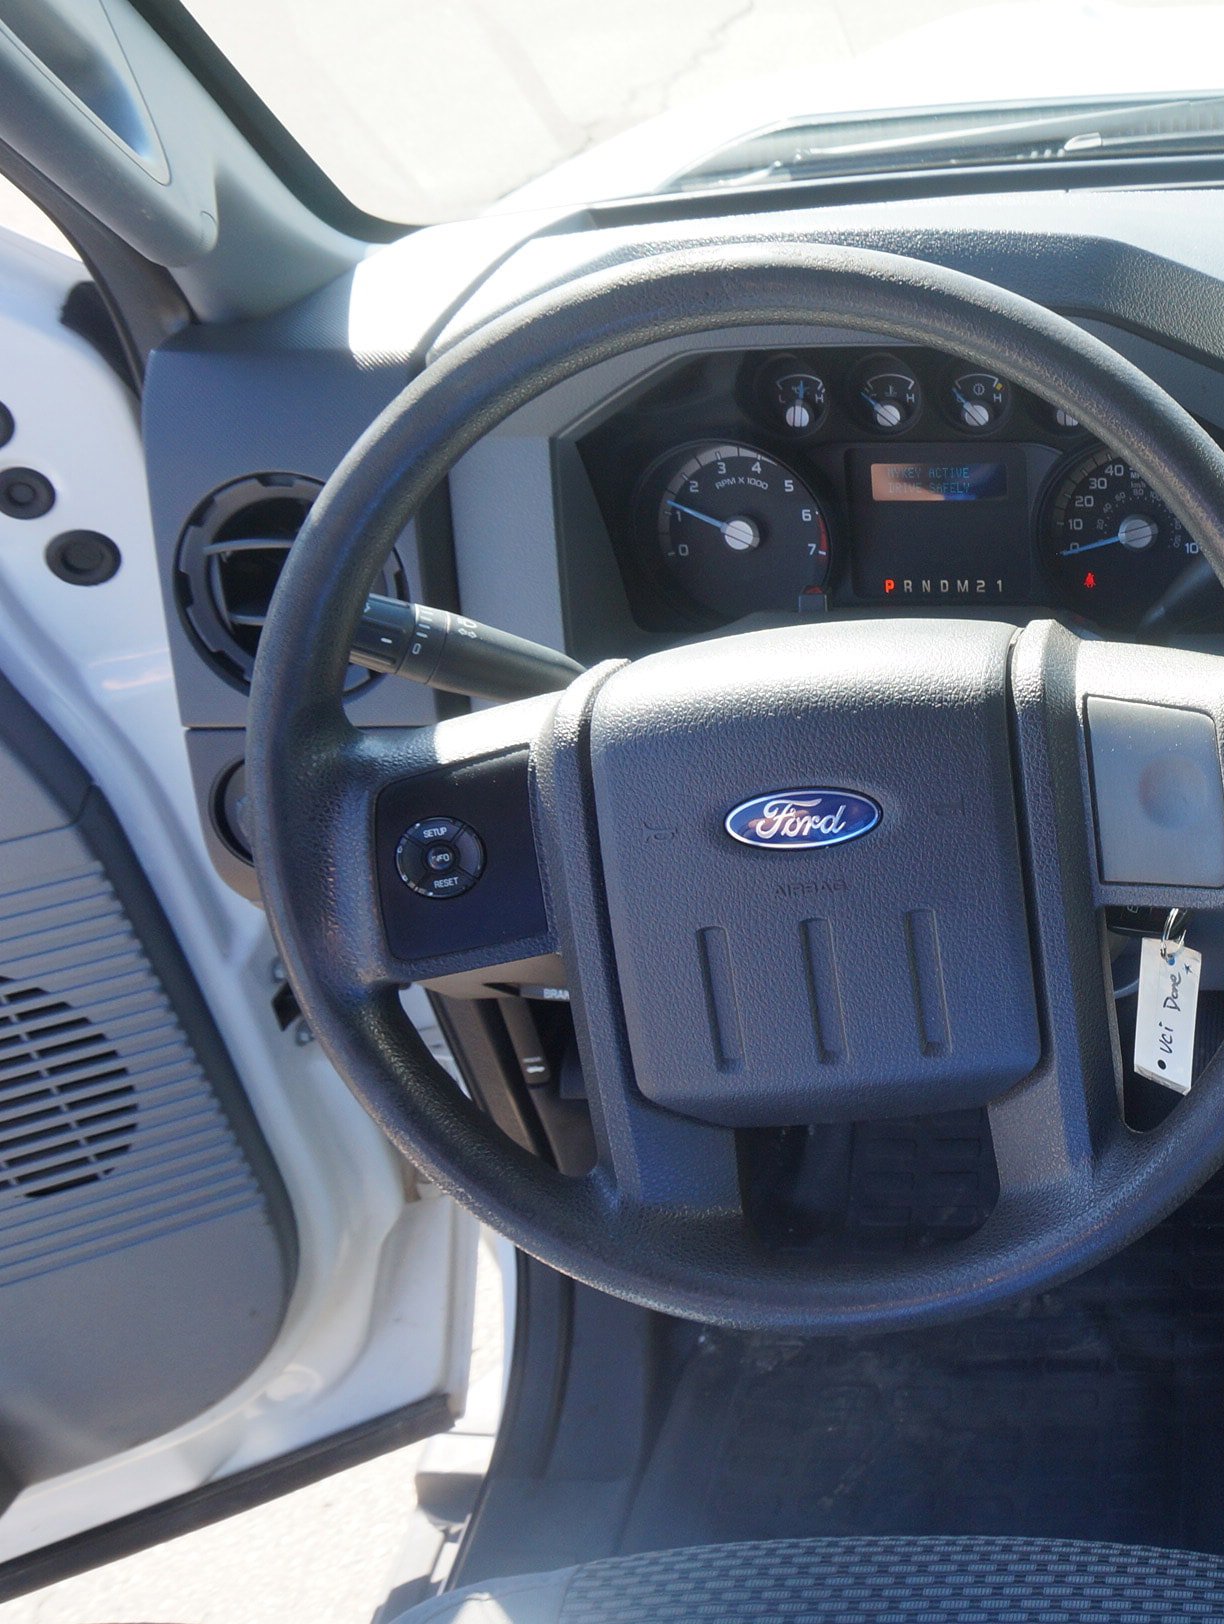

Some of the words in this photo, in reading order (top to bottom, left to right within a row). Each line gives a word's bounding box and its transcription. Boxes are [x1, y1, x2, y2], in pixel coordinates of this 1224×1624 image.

[717, 461, 727, 474] 3
[751, 462, 762, 474] 4
[928, 466, 970, 479] ACTIVE
[1104, 464, 1125, 477] 40
[689, 480, 699, 492] 2
[715, 477, 736, 490] RPM
[747, 477, 769, 490] 1000
[784, 479, 794, 492] 5
[1088, 477, 1108, 490] 30
[1074, 495, 1094, 508] 20
[676, 510, 682, 522] 1
[801, 509, 812, 521] 6
[1068, 518, 1083, 531] 10
[678, 544, 689, 556] 0
[807, 543, 817, 555] 7
[1184, 542, 1199, 554] 10
[884, 579, 895, 593] P
[903, 579, 913, 592] R
[922, 579, 931, 592] N
[940, 579, 949, 592] D
[957, 579, 969, 592] M
[976, 579, 986, 592] 2
[996, 579, 1003, 592] 1
[756, 798, 847, 839] Ford
[423, 826, 447, 838] SETUP
[433, 876, 459, 889] RESET
[1162, 971, 1182, 1012] Done
